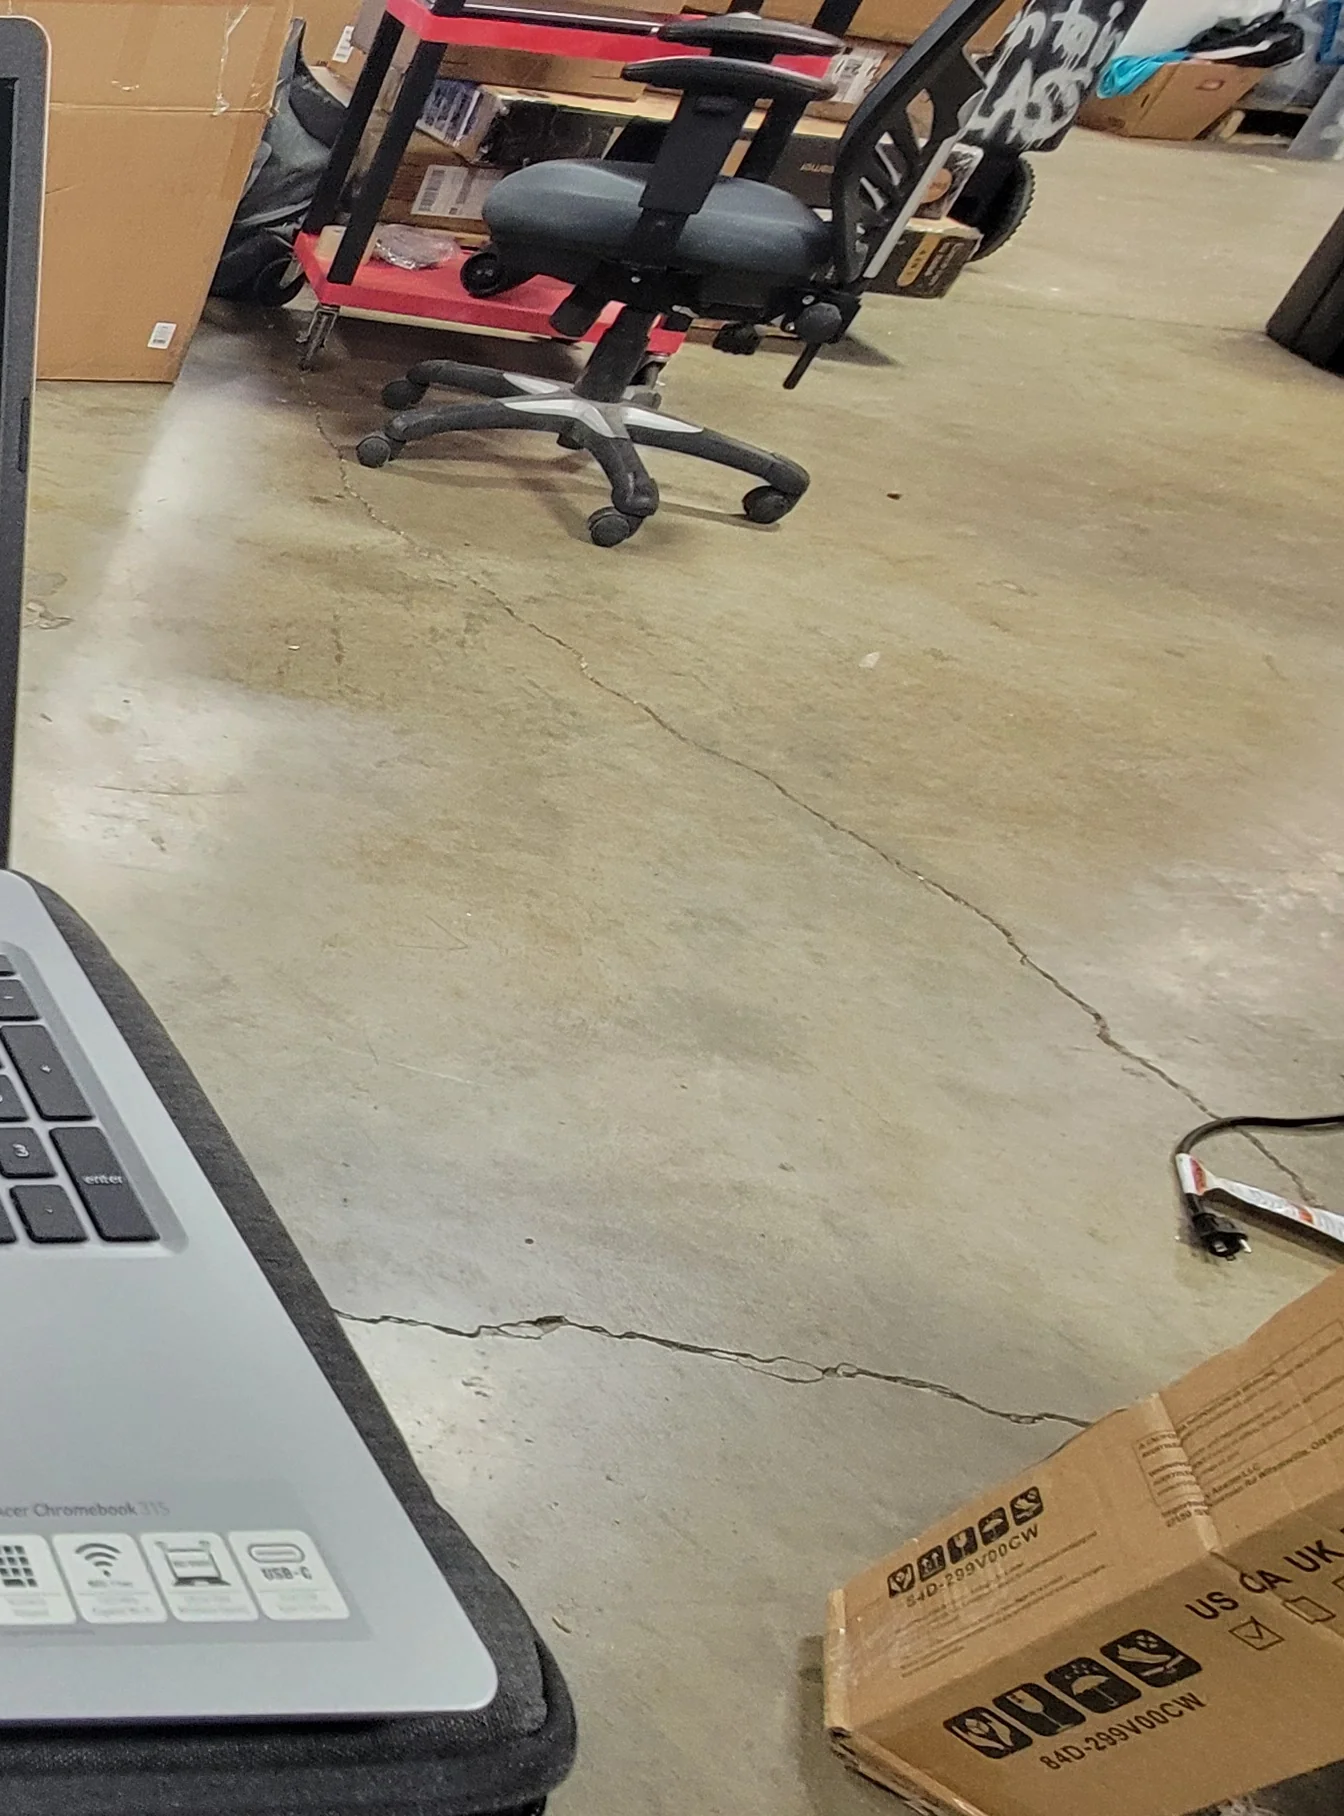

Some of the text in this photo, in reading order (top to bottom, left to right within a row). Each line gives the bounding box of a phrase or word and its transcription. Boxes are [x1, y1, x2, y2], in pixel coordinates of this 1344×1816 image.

[13, 1144, 29, 1157] 3
[82, 1176, 122, 1184] enter
[33, 1502, 138, 1518] Chromebook
[1185, 1539, 1344, 1620] US CA UK
[1039, 1691, 1208, 1771] 84D-299V00CW
